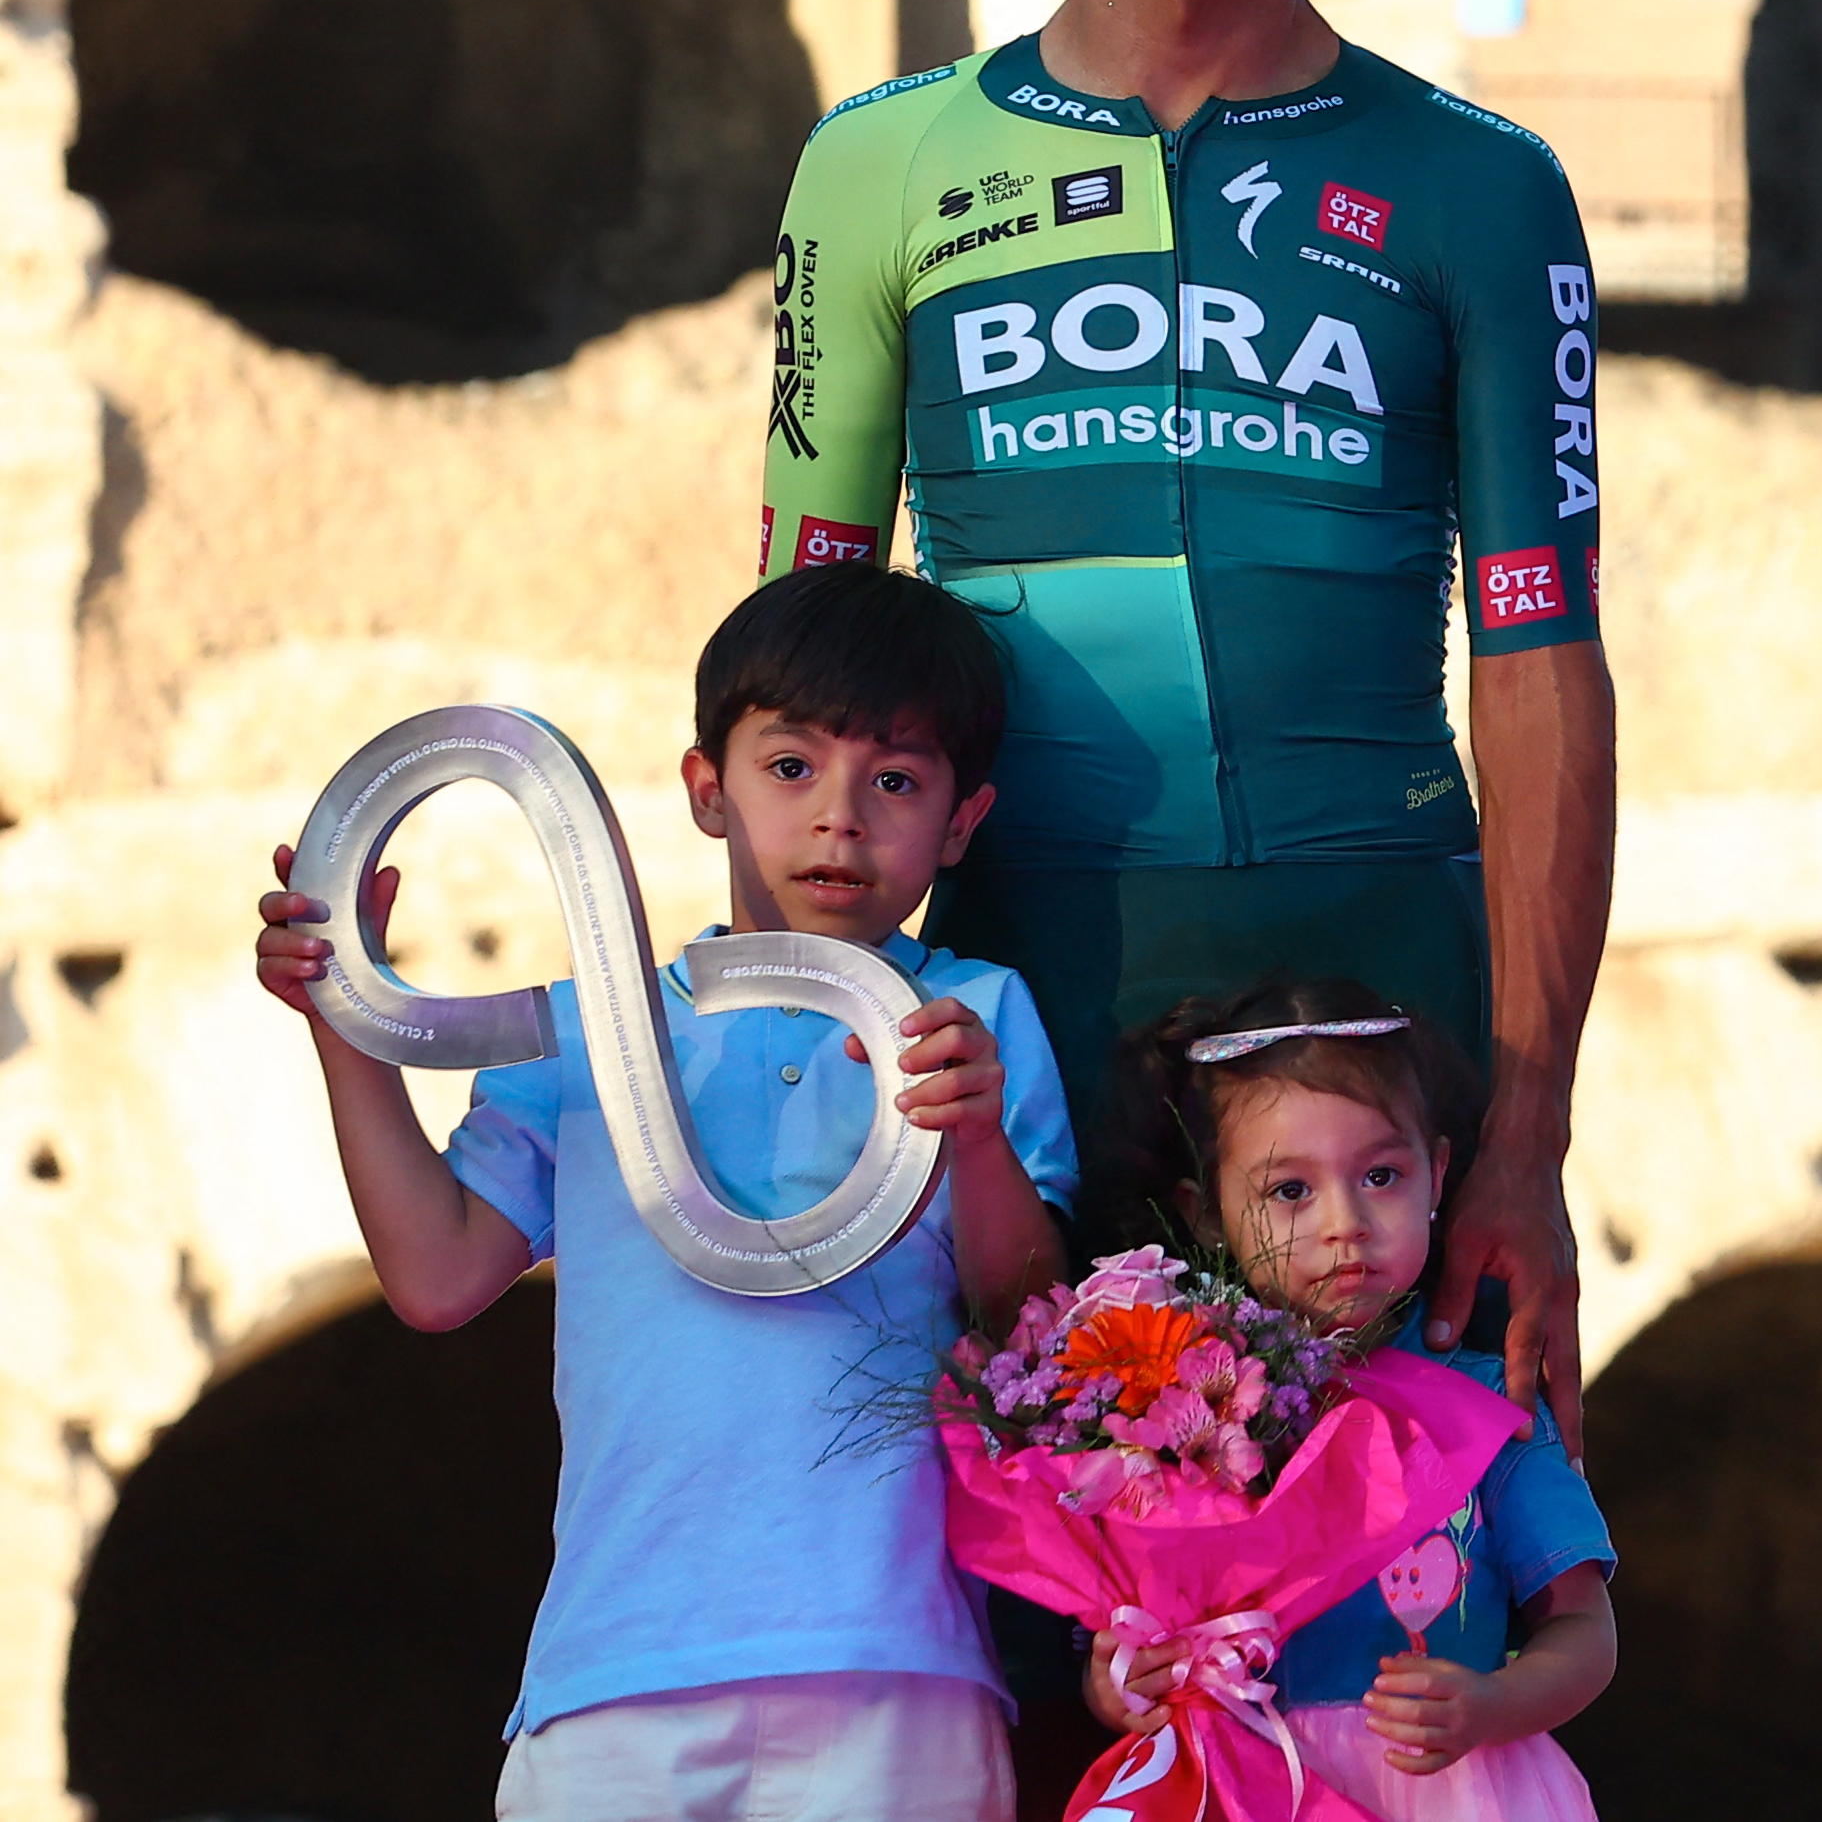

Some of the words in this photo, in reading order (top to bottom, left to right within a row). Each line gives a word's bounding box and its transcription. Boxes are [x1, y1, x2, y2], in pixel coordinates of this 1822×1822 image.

[1006, 83, 1121, 128] BORA
[1222, 93, 1345, 126] hansgrohe
[979, 170, 1010, 187] UCI
[981, 174, 1036, 197] WORLD
[983, 187, 1024, 206] TEAM
[1066, 200, 1111, 216] sportful
[1328, 190, 1382, 227] ÖTZ
[917, 213, 1040, 274] GRENKE
[1326, 211, 1377, 244] TAL
[800, 238, 820, 309] OVEN
[1298, 245, 1403, 295] SRAM
[800, 313, 816, 370] FLEX
[953, 282, 1385, 416] BORA
[801, 368, 816, 421] THE
[1547, 264, 1598, 521] BORA
[977, 400, 1371, 465] hansgrohe
[1487, 564, 1552, 593] ÖTZ
[1489, 590, 1557, 618] TAL
[1406, 775, 1455, 810] Brothers
